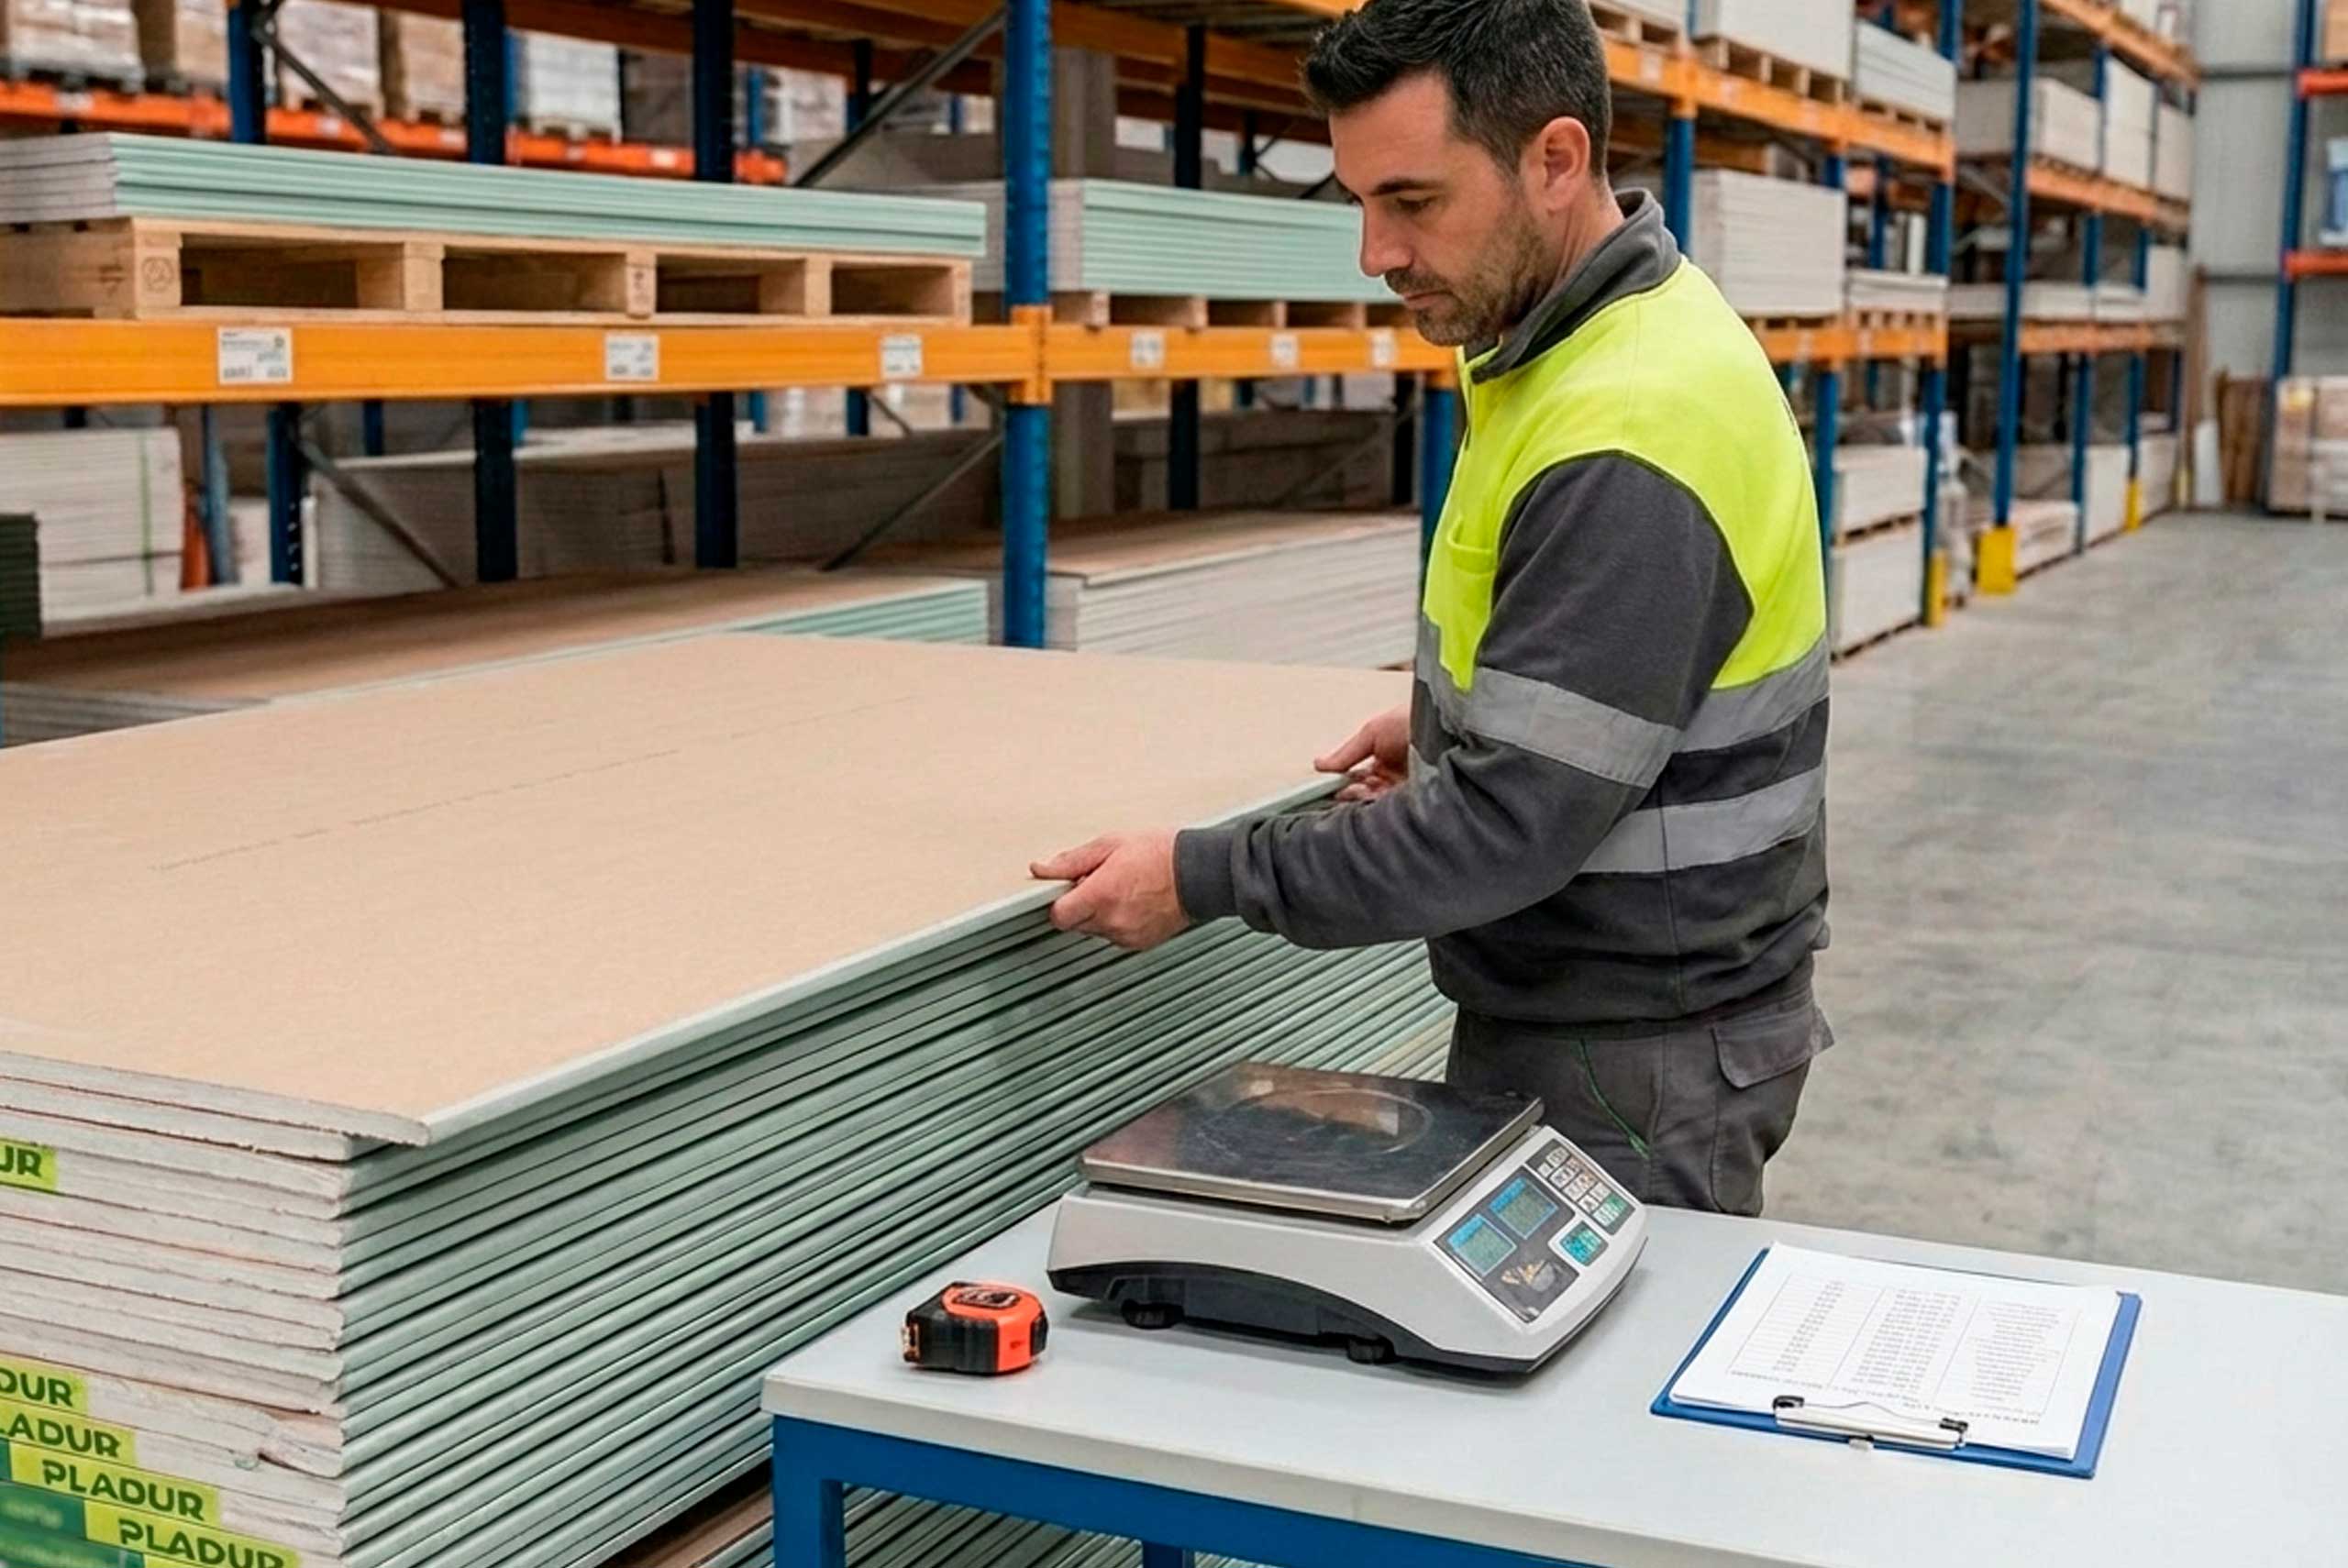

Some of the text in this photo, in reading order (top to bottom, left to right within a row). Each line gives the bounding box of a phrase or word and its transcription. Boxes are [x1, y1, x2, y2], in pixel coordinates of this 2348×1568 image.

[0, 1367, 72, 1407] DUR
[0, 1413, 120, 1457] ADUR
[42, 1459, 204, 1520] PLADUR
